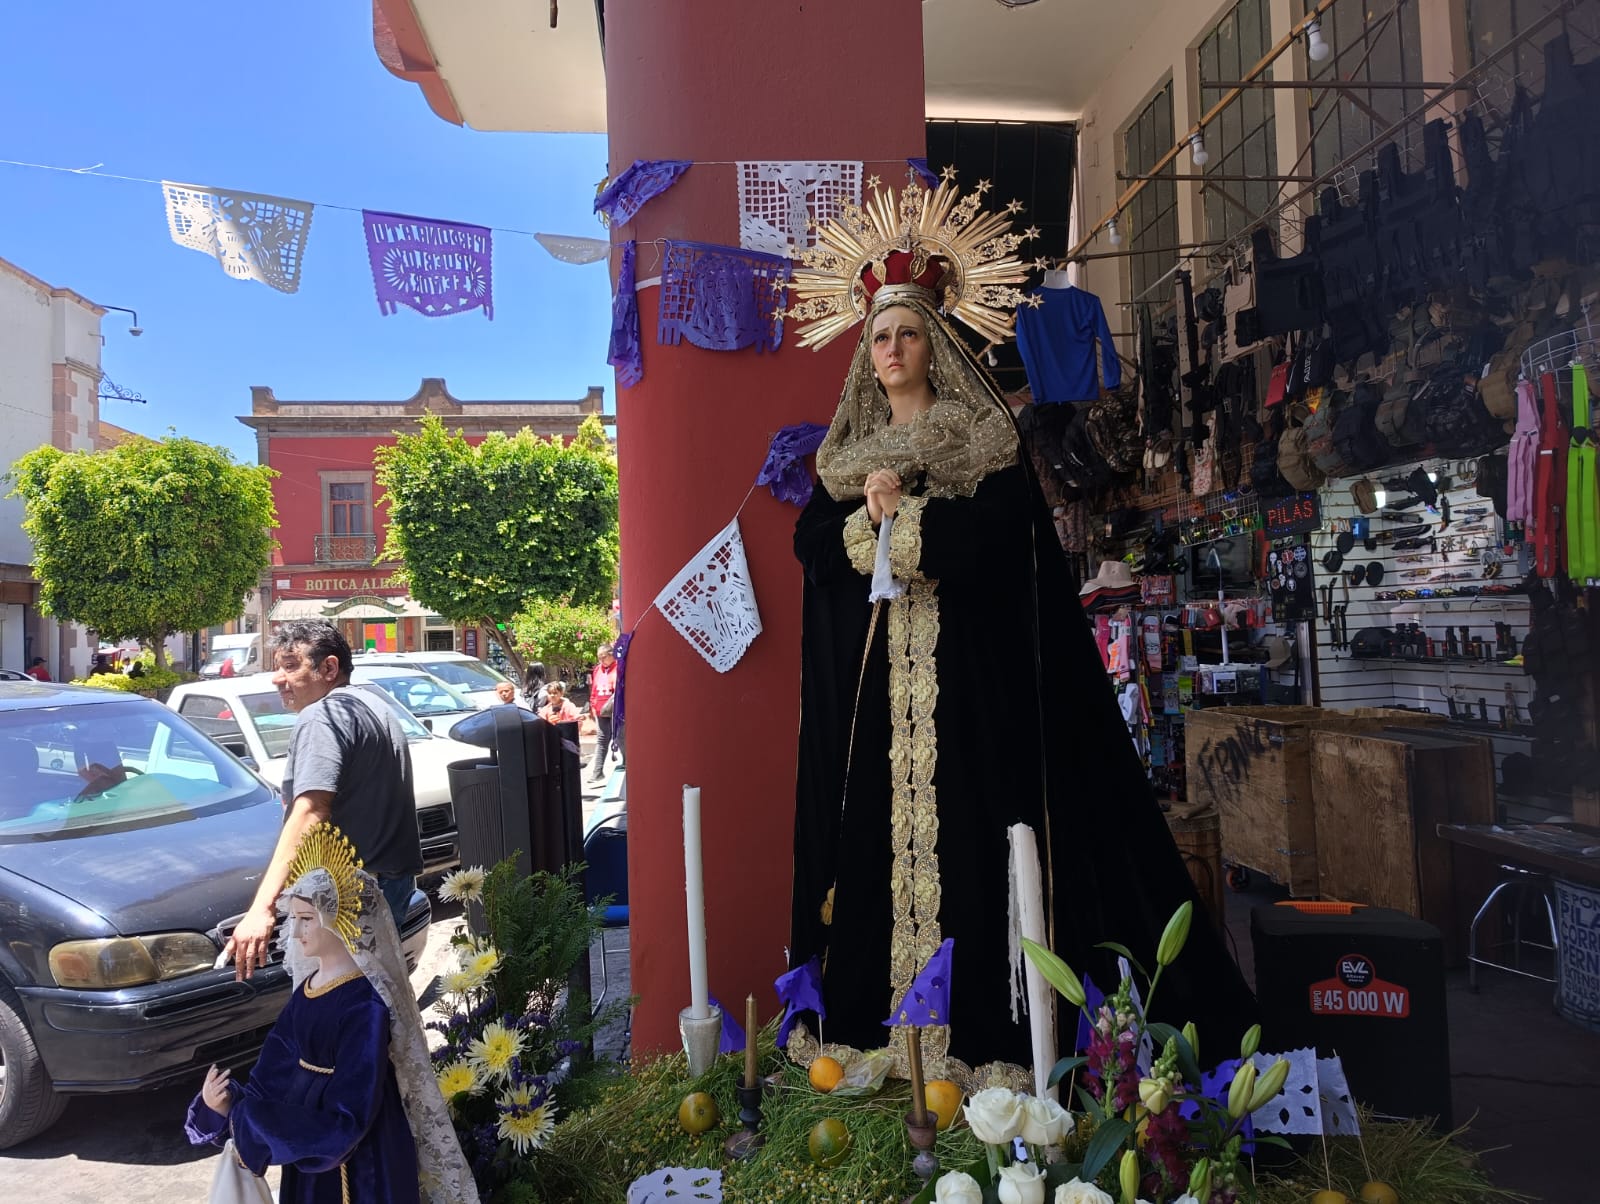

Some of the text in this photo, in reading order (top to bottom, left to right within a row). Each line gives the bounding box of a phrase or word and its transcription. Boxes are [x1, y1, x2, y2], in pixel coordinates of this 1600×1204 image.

[1267, 500, 1313, 527] PILAS
[305, 578, 358, 591] BOTICA
[1323, 990, 1344, 1010] 45
[1347, 990, 1379, 1012] 000
[1382, 991, 1405, 1014] W
